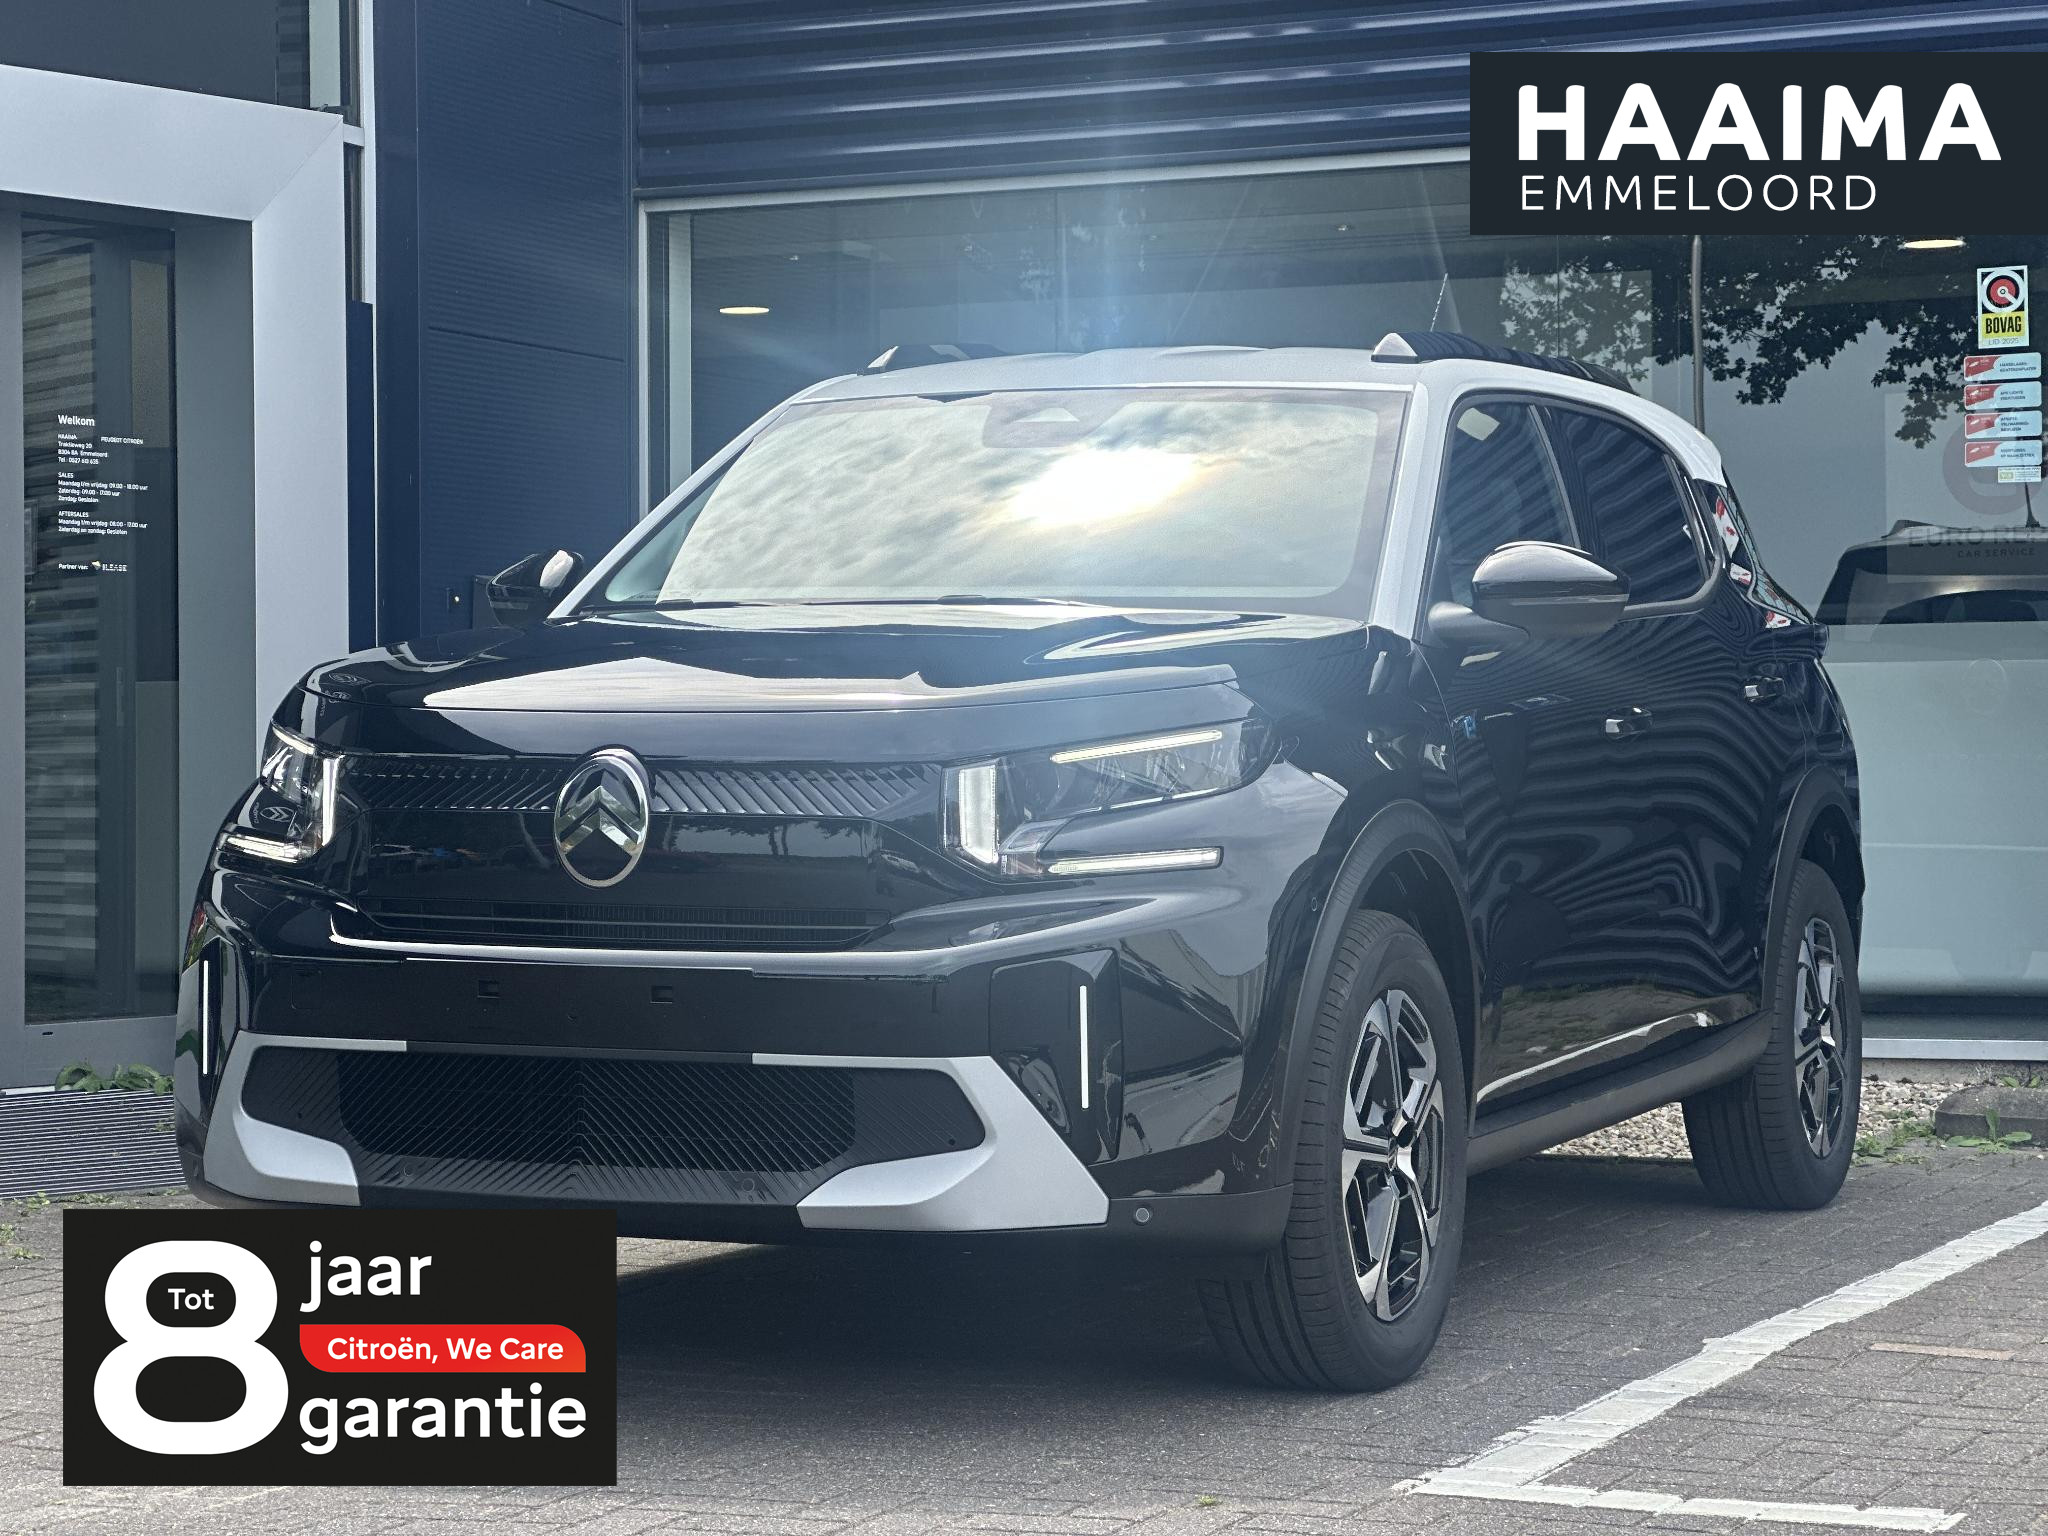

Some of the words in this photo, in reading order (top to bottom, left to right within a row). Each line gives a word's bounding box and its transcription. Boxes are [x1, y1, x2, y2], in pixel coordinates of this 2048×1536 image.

[1985, 315, 2022, 334] BOVAG
[58, 415, 95, 426] Welkom
[57, 480, 80, 488] Maandag
[58, 518, 81, 526] Maandag
[1957, 550, 1981, 559] CAR
[1984, 547, 2035, 558] SERVICE
